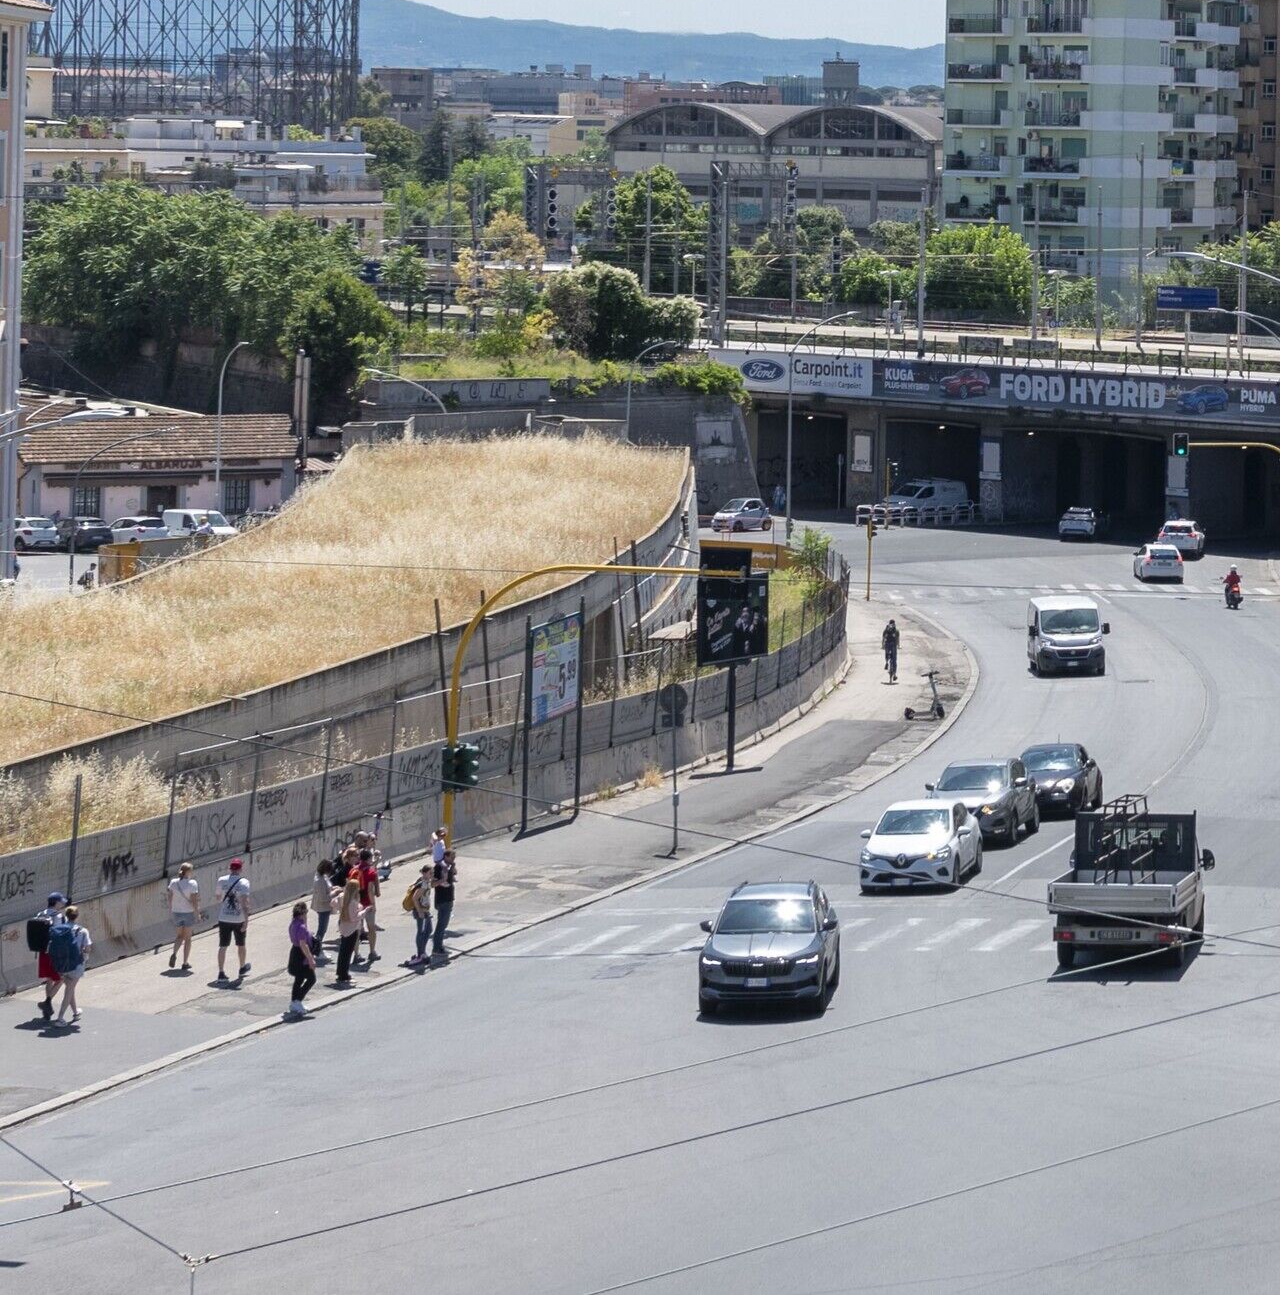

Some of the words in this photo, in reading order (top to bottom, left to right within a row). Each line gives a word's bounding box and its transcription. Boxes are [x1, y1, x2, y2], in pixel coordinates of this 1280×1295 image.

[749, 363, 777, 379] Ford
[794, 359, 863, 378] Carpoint.it
[885, 368, 914, 381] KUGA
[1000, 373, 1065, 403] FORD
[1070, 377, 1166, 409] HYBRID
[1240, 387, 1276, 405] PUMA
[1240, 404, 1265, 413] HYBRID
